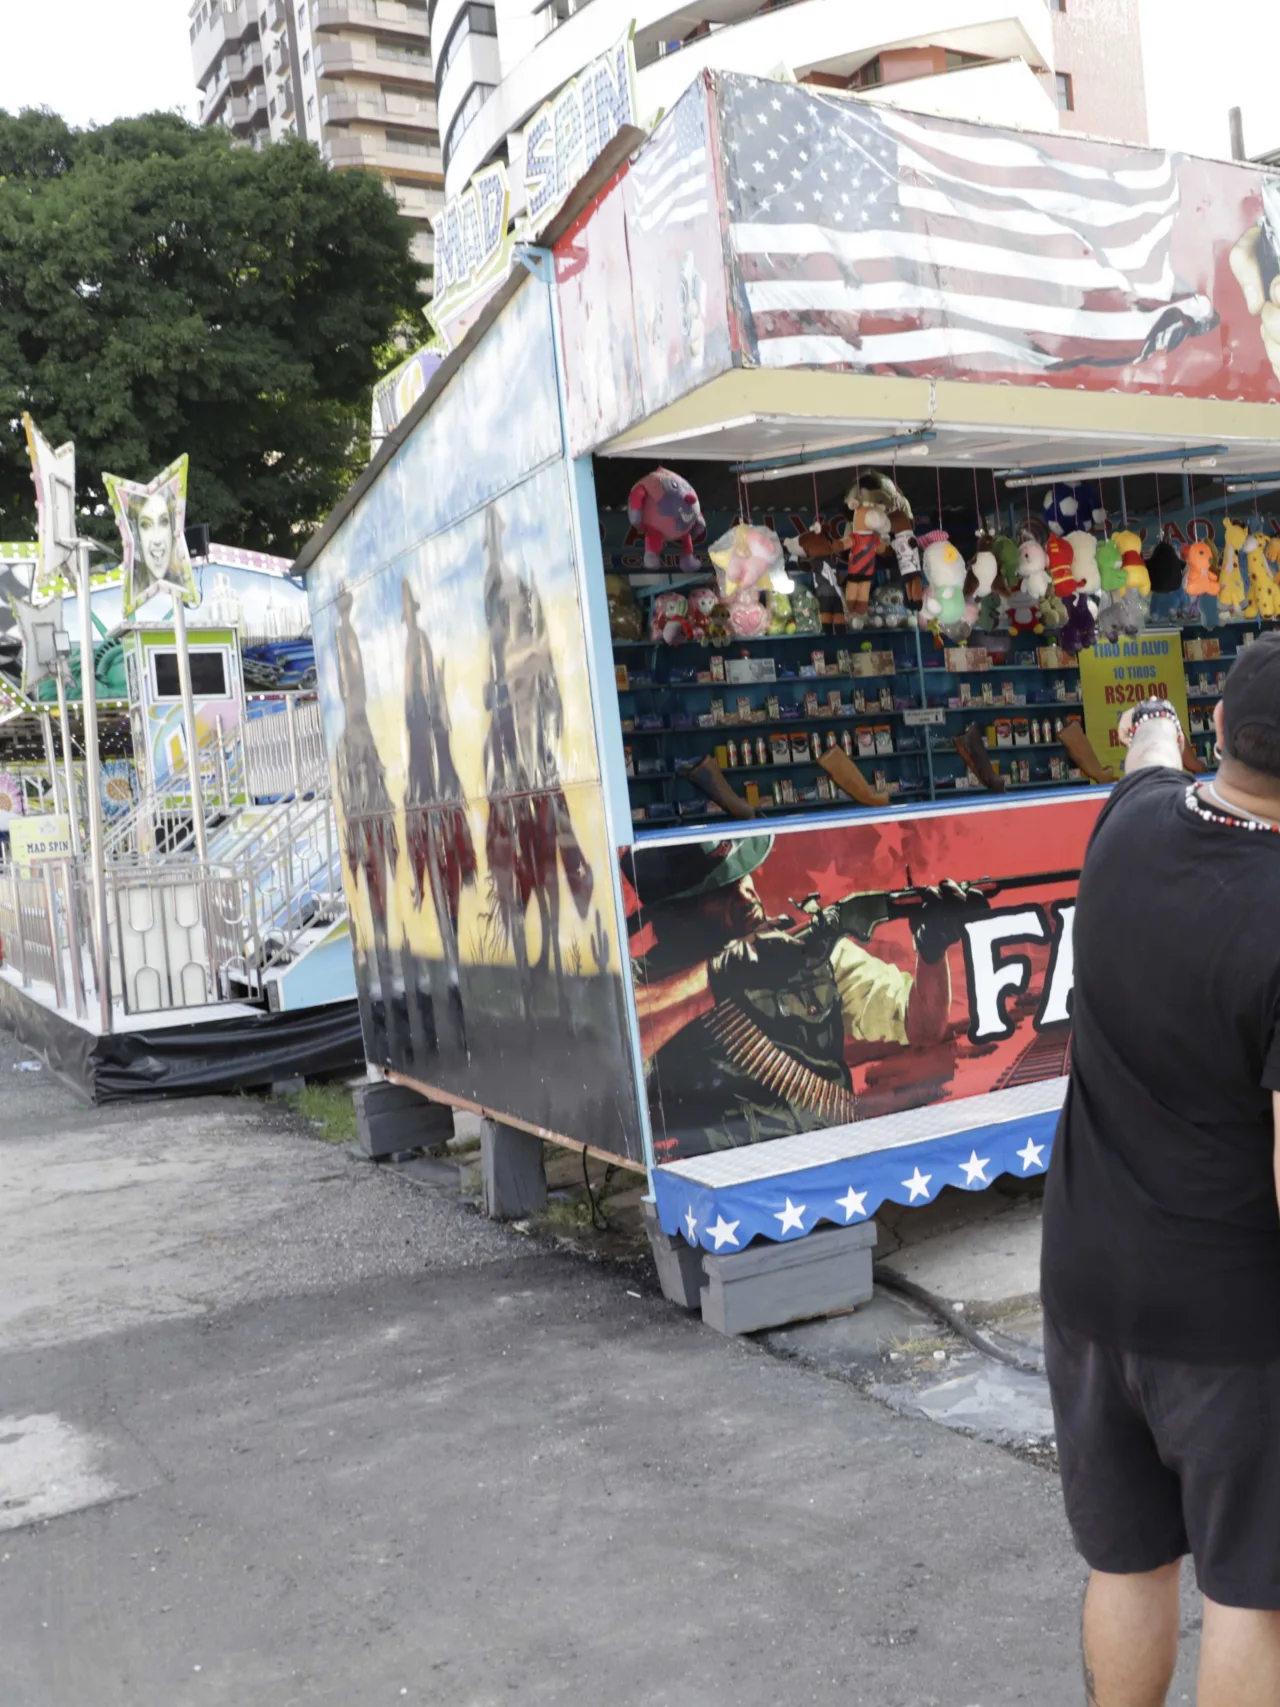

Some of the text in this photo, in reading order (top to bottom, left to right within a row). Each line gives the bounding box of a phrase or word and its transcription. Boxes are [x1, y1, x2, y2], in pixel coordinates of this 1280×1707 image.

[433, 42, 634, 298] MAD SPIN
[1093, 640, 1169, 658] TIRO AO ALVO
[1113, 665, 1157, 680] 10 TIROS
[27, 840, 69, 853] MAD SPIN
